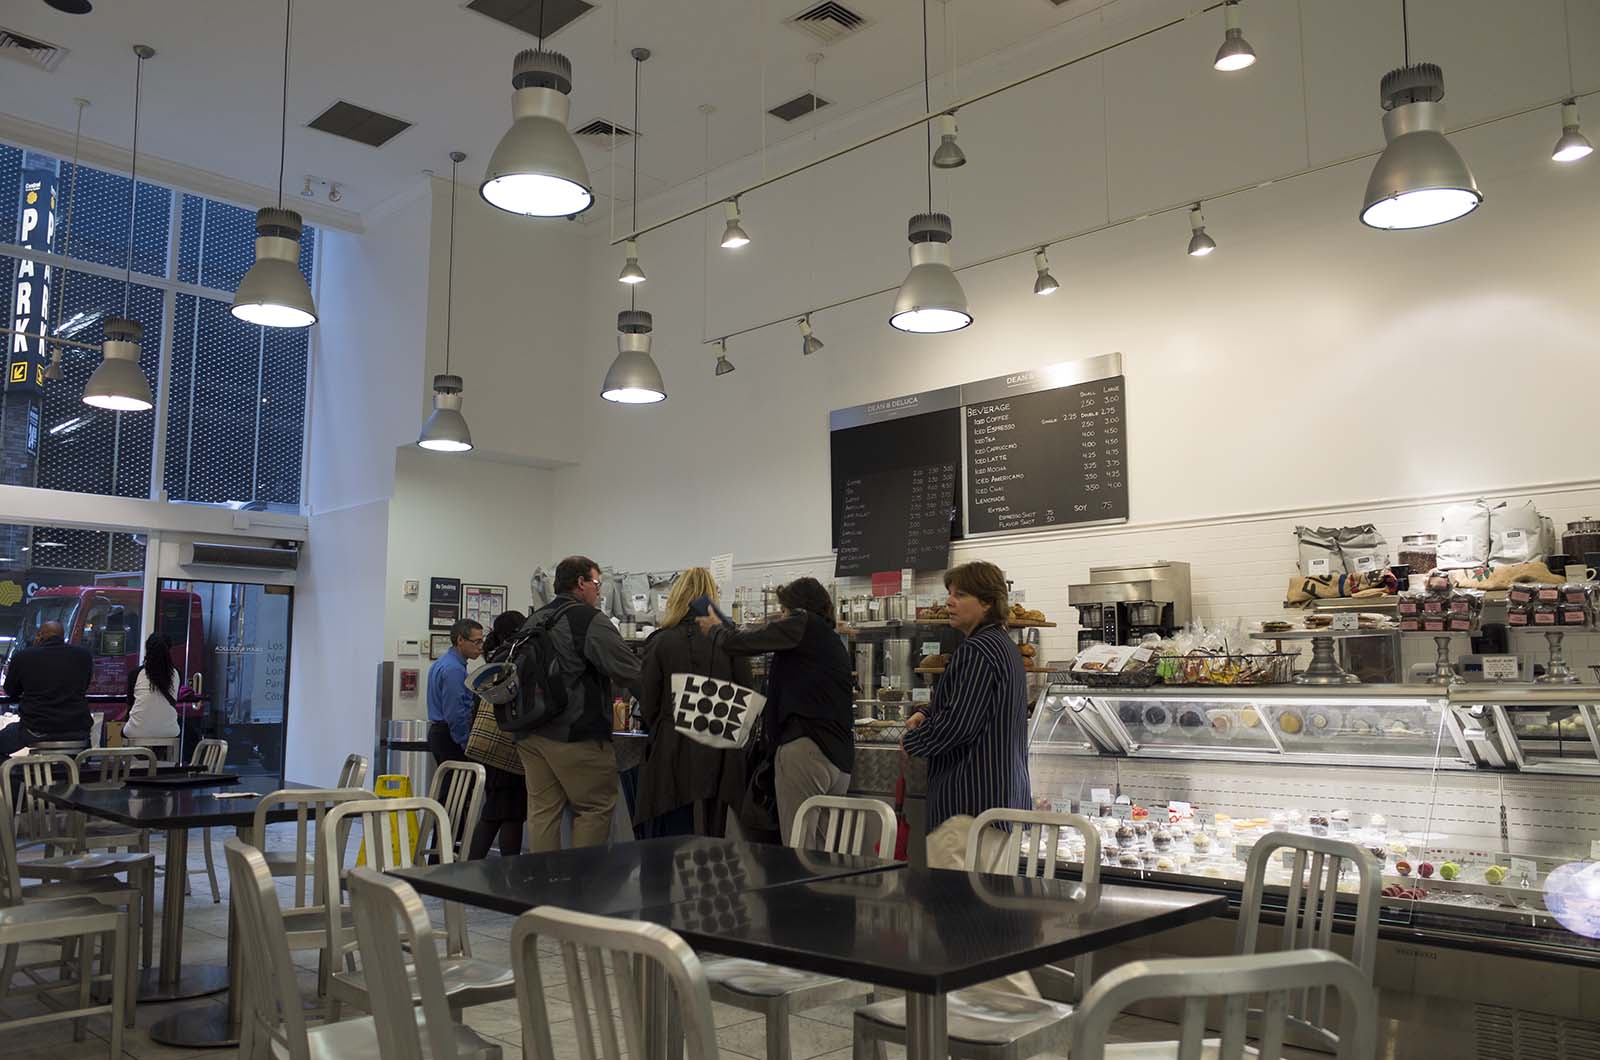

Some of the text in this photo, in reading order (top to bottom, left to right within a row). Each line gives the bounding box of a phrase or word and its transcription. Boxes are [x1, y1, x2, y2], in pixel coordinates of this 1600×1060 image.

[14, 208, 38, 353] PARK
[38, 211, 54, 358] PARK
[867, 403, 885, 412] DEAN
[891, 397, 918, 407] DELUCA
[968, 403, 1010, 417] BEVERAGE
[987, 454, 1007, 463] LATTE
[268, 640, 284, 650] Los
[684, 676, 752, 707] LOOK
[680, 694, 746, 724] LOOK
[676, 711, 741, 742] LOOK
